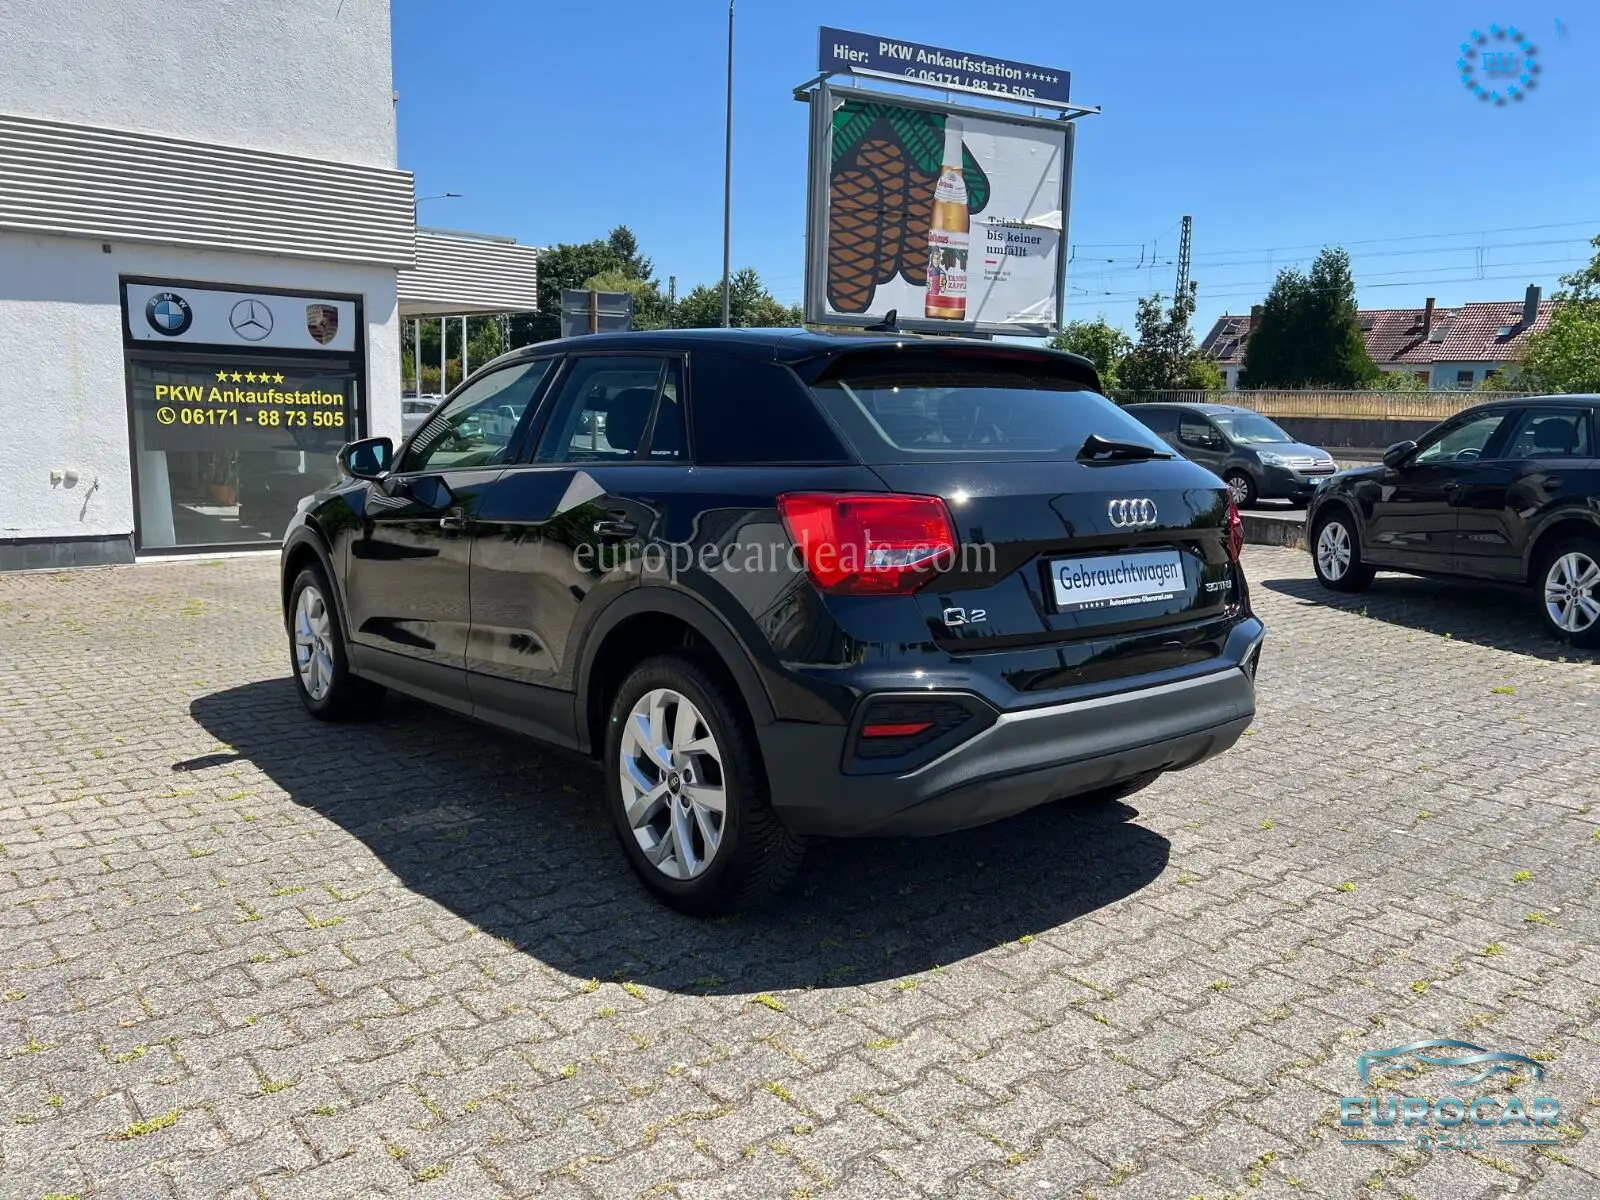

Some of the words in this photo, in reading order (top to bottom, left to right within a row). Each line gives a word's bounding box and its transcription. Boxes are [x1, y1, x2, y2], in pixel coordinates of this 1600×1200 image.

[833, 43, 869, 64] Hier:
[879, 42, 914, 61] PKW
[917, 49, 1022, 80] Ankaufsstation
[987, 230, 1004, 241] bis
[1007, 232, 1042, 245] keiner
[986, 245, 1028, 257] umfällt
[150, 293, 188, 308] BMW
[155, 384, 204, 402] PKW
[208, 386, 343, 405] Ankaufsstation
[180, 407, 238, 425] 06171
[258, 410, 280, 426] 88
[285, 410, 307, 427] 73
[312, 411, 344, 427] 505
[1060, 560, 1179, 590] Gebrauchtwagen
[943, 607, 987, 626] Q2
